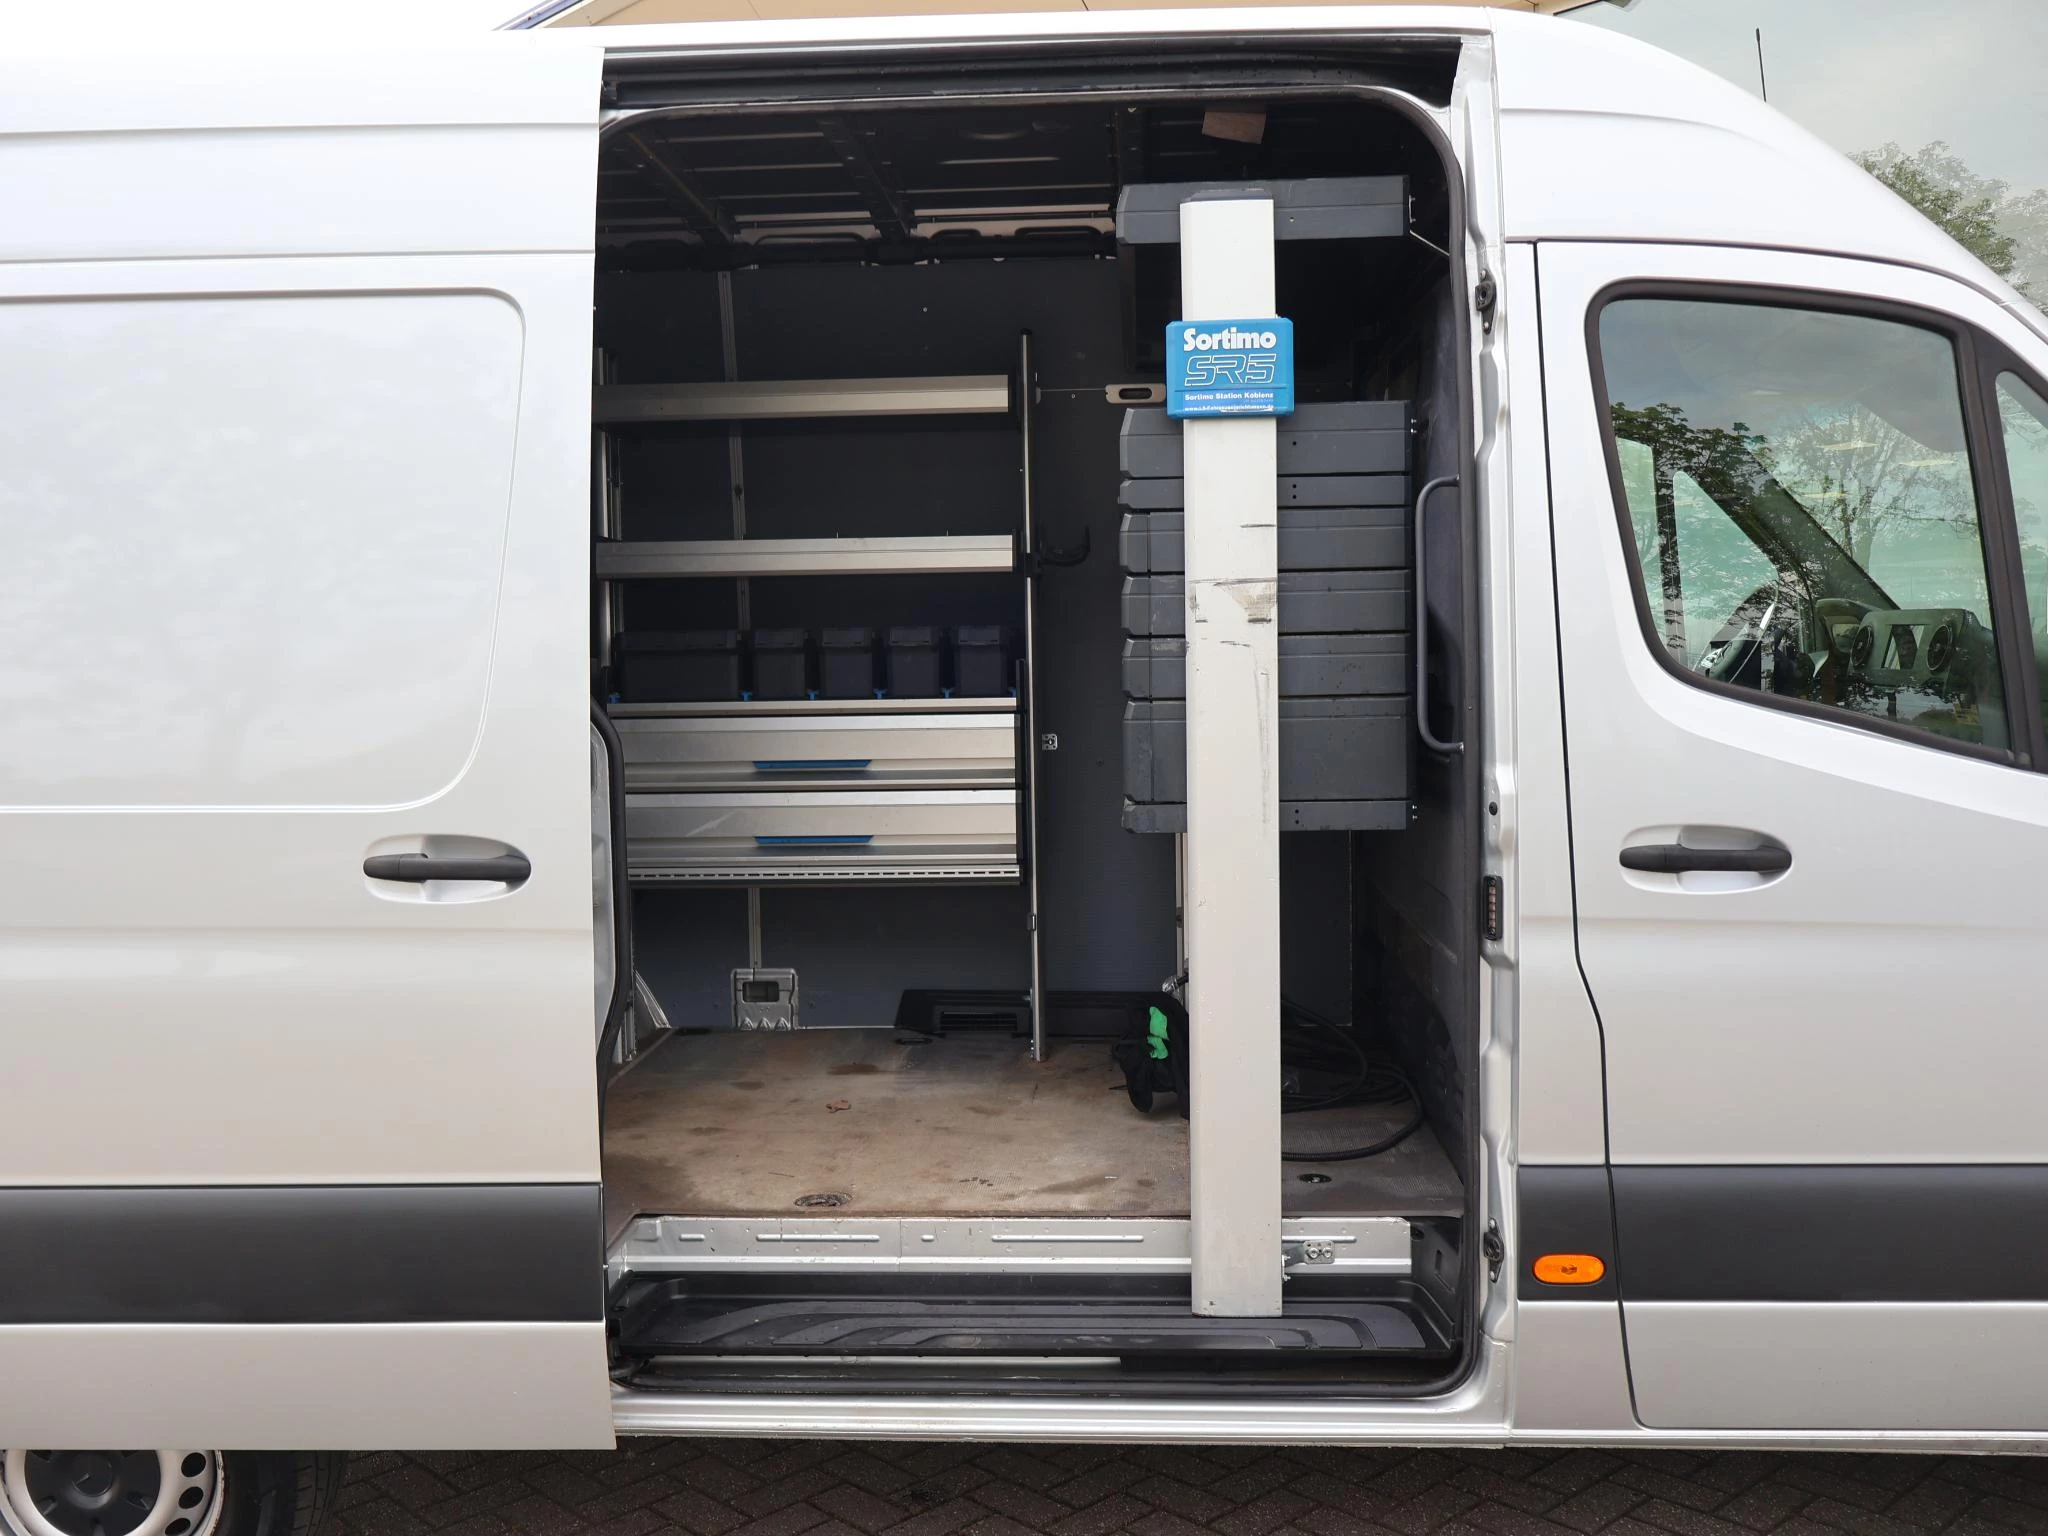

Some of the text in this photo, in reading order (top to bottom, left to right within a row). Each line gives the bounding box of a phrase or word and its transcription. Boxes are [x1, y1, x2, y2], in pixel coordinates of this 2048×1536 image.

[1183, 327, 1277, 351] Sortimo
[1184, 354, 1277, 387] SR5
[1184, 391, 1274, 401] Sortimo Station Koblenz
